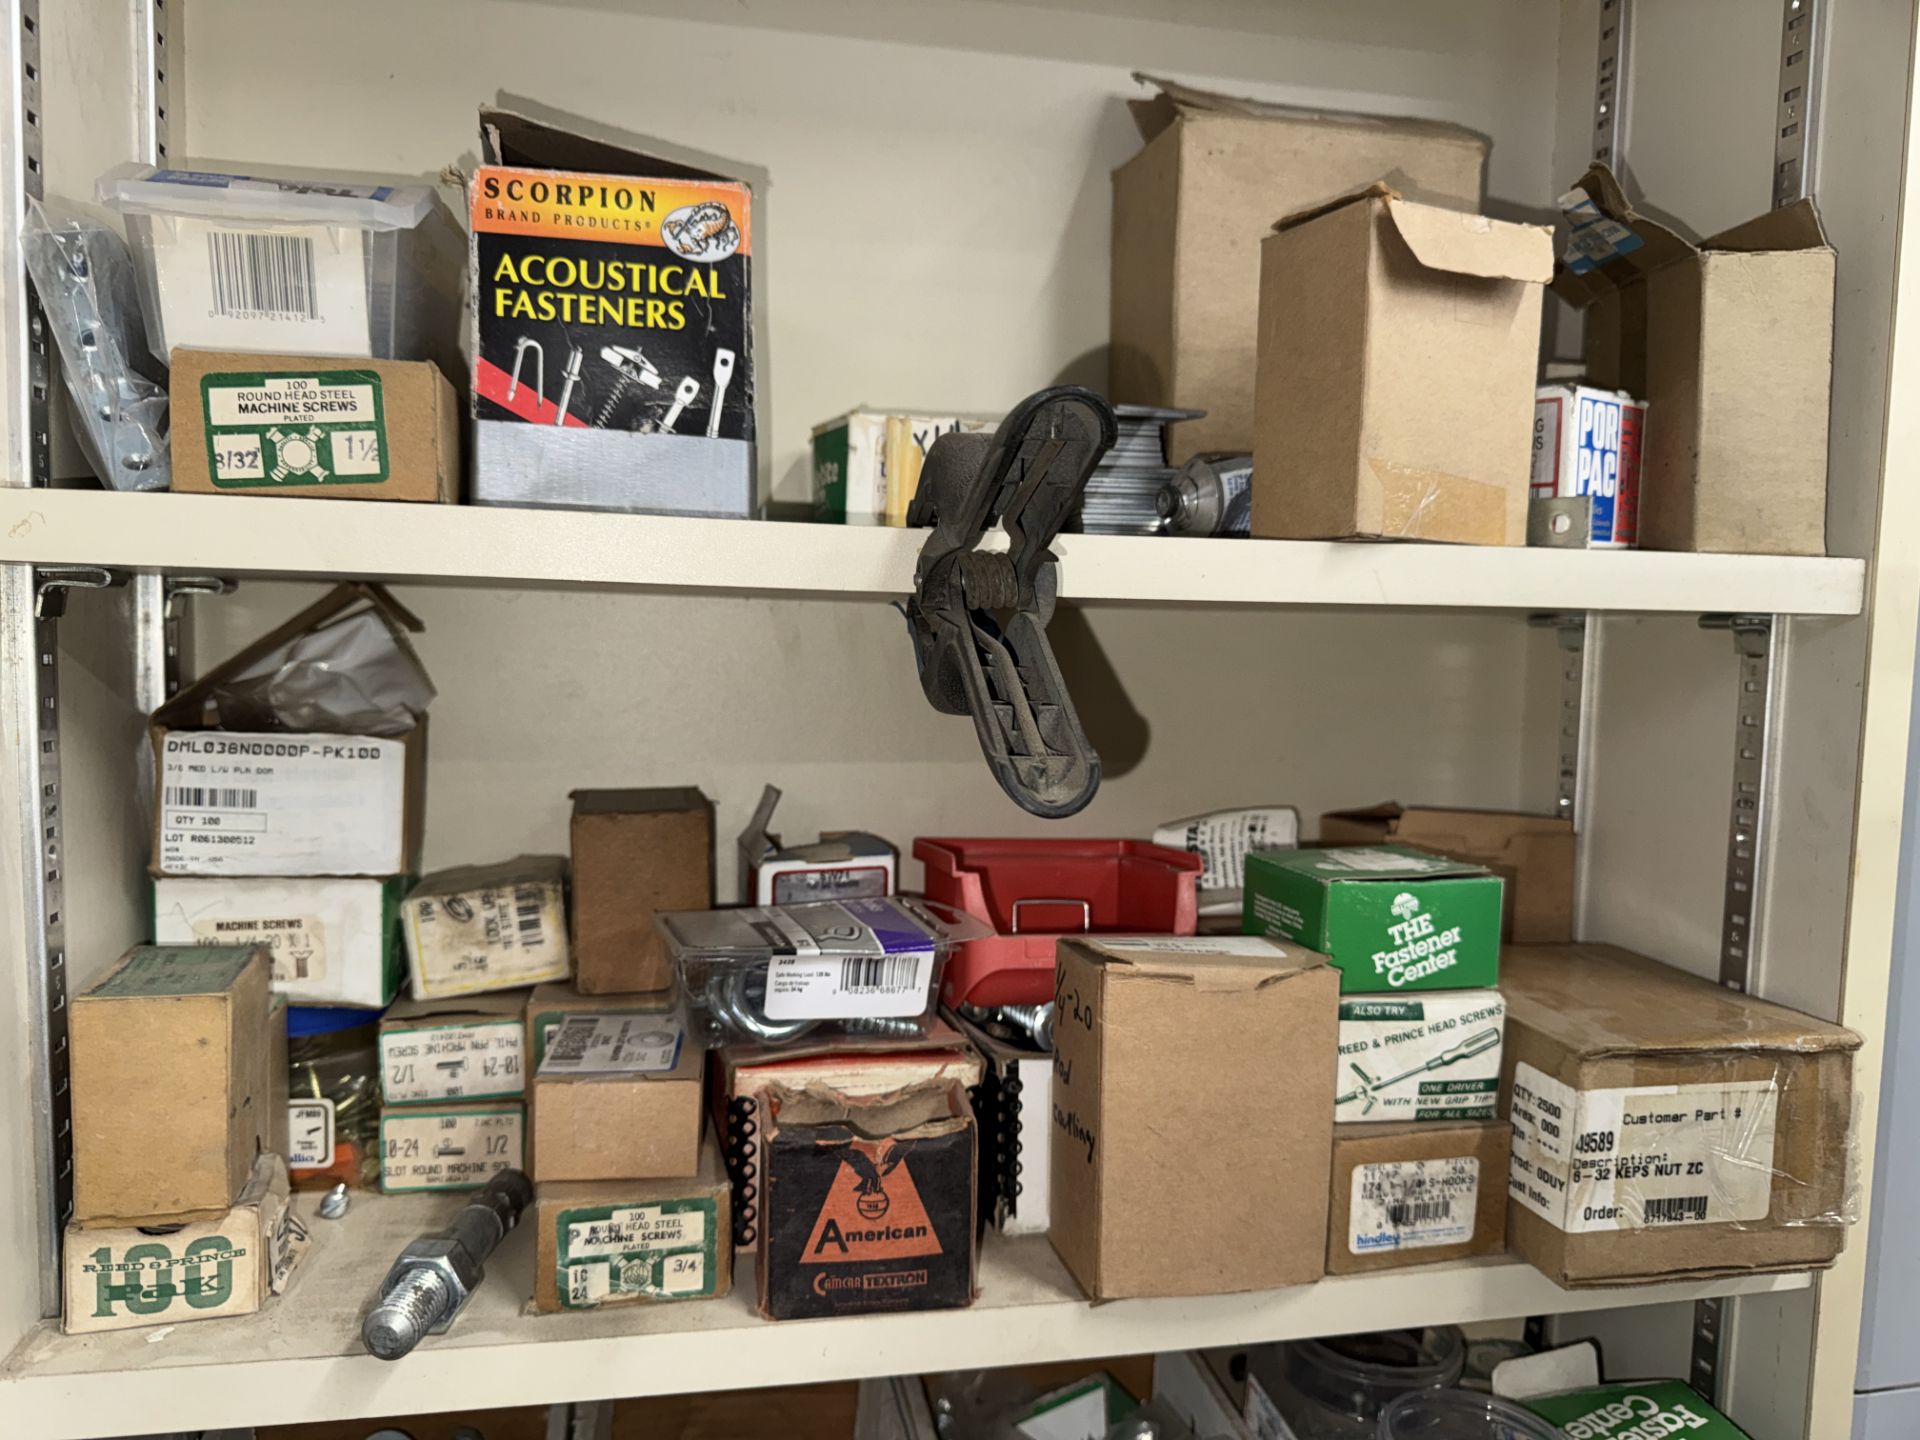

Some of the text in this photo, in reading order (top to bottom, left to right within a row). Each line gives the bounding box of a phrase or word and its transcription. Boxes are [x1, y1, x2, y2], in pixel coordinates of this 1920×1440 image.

[484, 177, 656, 213] SCORPION
[484, 208, 541, 224] BRAND
[493, 253, 727, 300] ACOUSTICAL
[494, 288, 687, 331] FASTENERS
[285, 380, 307, 391] 100
[237, 389, 356, 402] ROUND HEAD STEEL
[238, 401, 358, 415] MACHINE SCREWS
[283, 415, 314, 423] PLATED
[1580, 400, 1618, 451] POR
[1577, 447, 1616, 498] PAC
[175, 815, 221, 826] QTY 100
[165, 834, 184, 843] LOT
[216, 918, 303, 932] MACHINE SCREWS
[1387, 913, 1434, 946] THE
[1371, 926, 1462, 974] Fastener
[1387, 949, 1458, 988] Center
[1353, 1005, 1382, 1016] ALSO
[1338, 1004, 1502, 1055] REED & PRINCE HEAD SCREWS
[393, 1063, 416, 1084] 1/2
[1421, 1081, 1485, 1093] ONE DRIVER
[1382, 1097, 1411, 1106] WITH
[1415, 1096, 1441, 1105] NEW
[1445, 1095, 1469, 1105] GRIP
[1513, 1083, 1562, 1120] QTY: 2500
[1512, 1102, 1536, 1125] Area:
[1622, 1107, 1742, 1126] Customer Part #
[486, 1134, 509, 1155] 1/2
[1575, 1131, 1615, 1154] 49589
[1572, 1153, 1668, 1170] Description:
[1615, 1165, 1650, 1179] KEPS
[1655, 1163, 1683, 1177] NUT
[1686, 1161, 1704, 1175] ZC
[1428, 1175, 1475, 1188] S-HOOKS
[1509, 1174, 1526, 1194] ust
[629, 1211, 646, 1222] 100
[1583, 1206, 1624, 1221] Order:
[626, 1220, 650, 1231] HEAD
[655, 1218, 684, 1229] STEEL
[641, 1229, 682, 1241] SCREWS
[813, 1218, 928, 1255] American
[1356, 1232, 1400, 1245] hindley
[622, 1242, 650, 1251] PLATED
[82, 1262, 146, 1274] REED
[165, 1248, 247, 1269] PRINCE
[673, 1258, 698, 1273] 3/4
[89, 1235, 233, 1317] 100
[865, 1272, 925, 1289] TEXTRON
[1565, 1394, 1660, 1440] Cente
[1613, 1404, 1710, 1440] Faste
